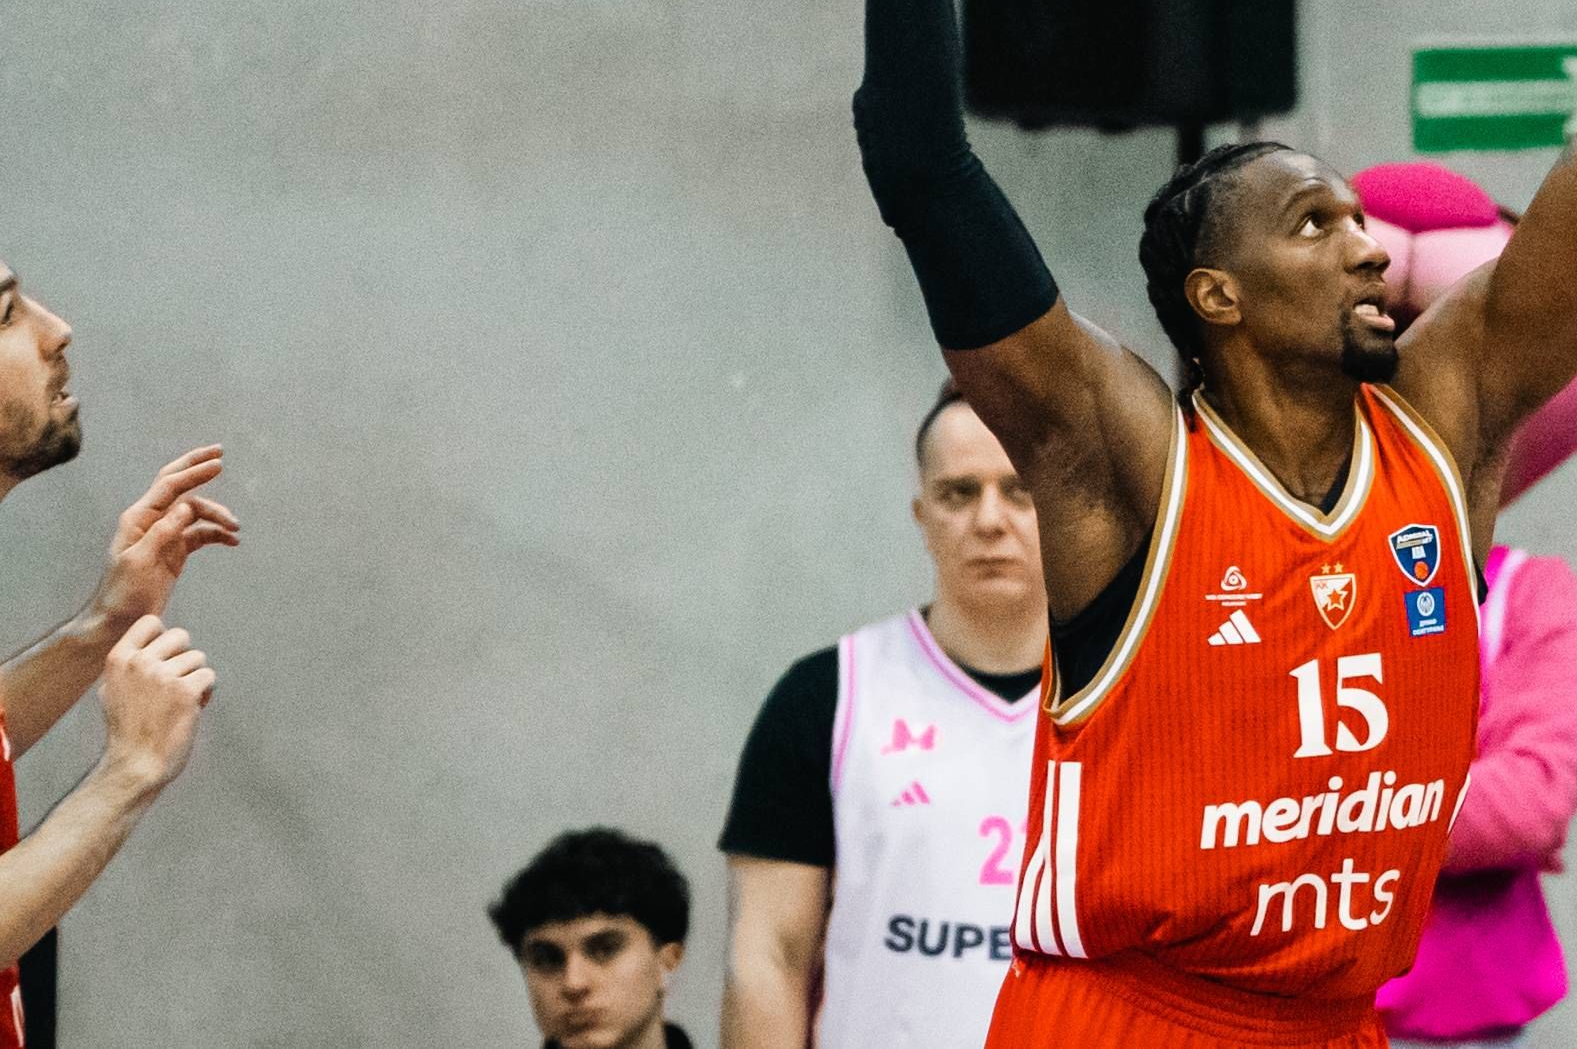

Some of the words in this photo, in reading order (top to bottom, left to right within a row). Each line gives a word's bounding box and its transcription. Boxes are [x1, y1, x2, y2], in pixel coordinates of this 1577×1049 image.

[1289, 652, 1389, 758] 15
[1200, 770, 1445, 849] meridian
[1250, 858, 1400, 936] mts
